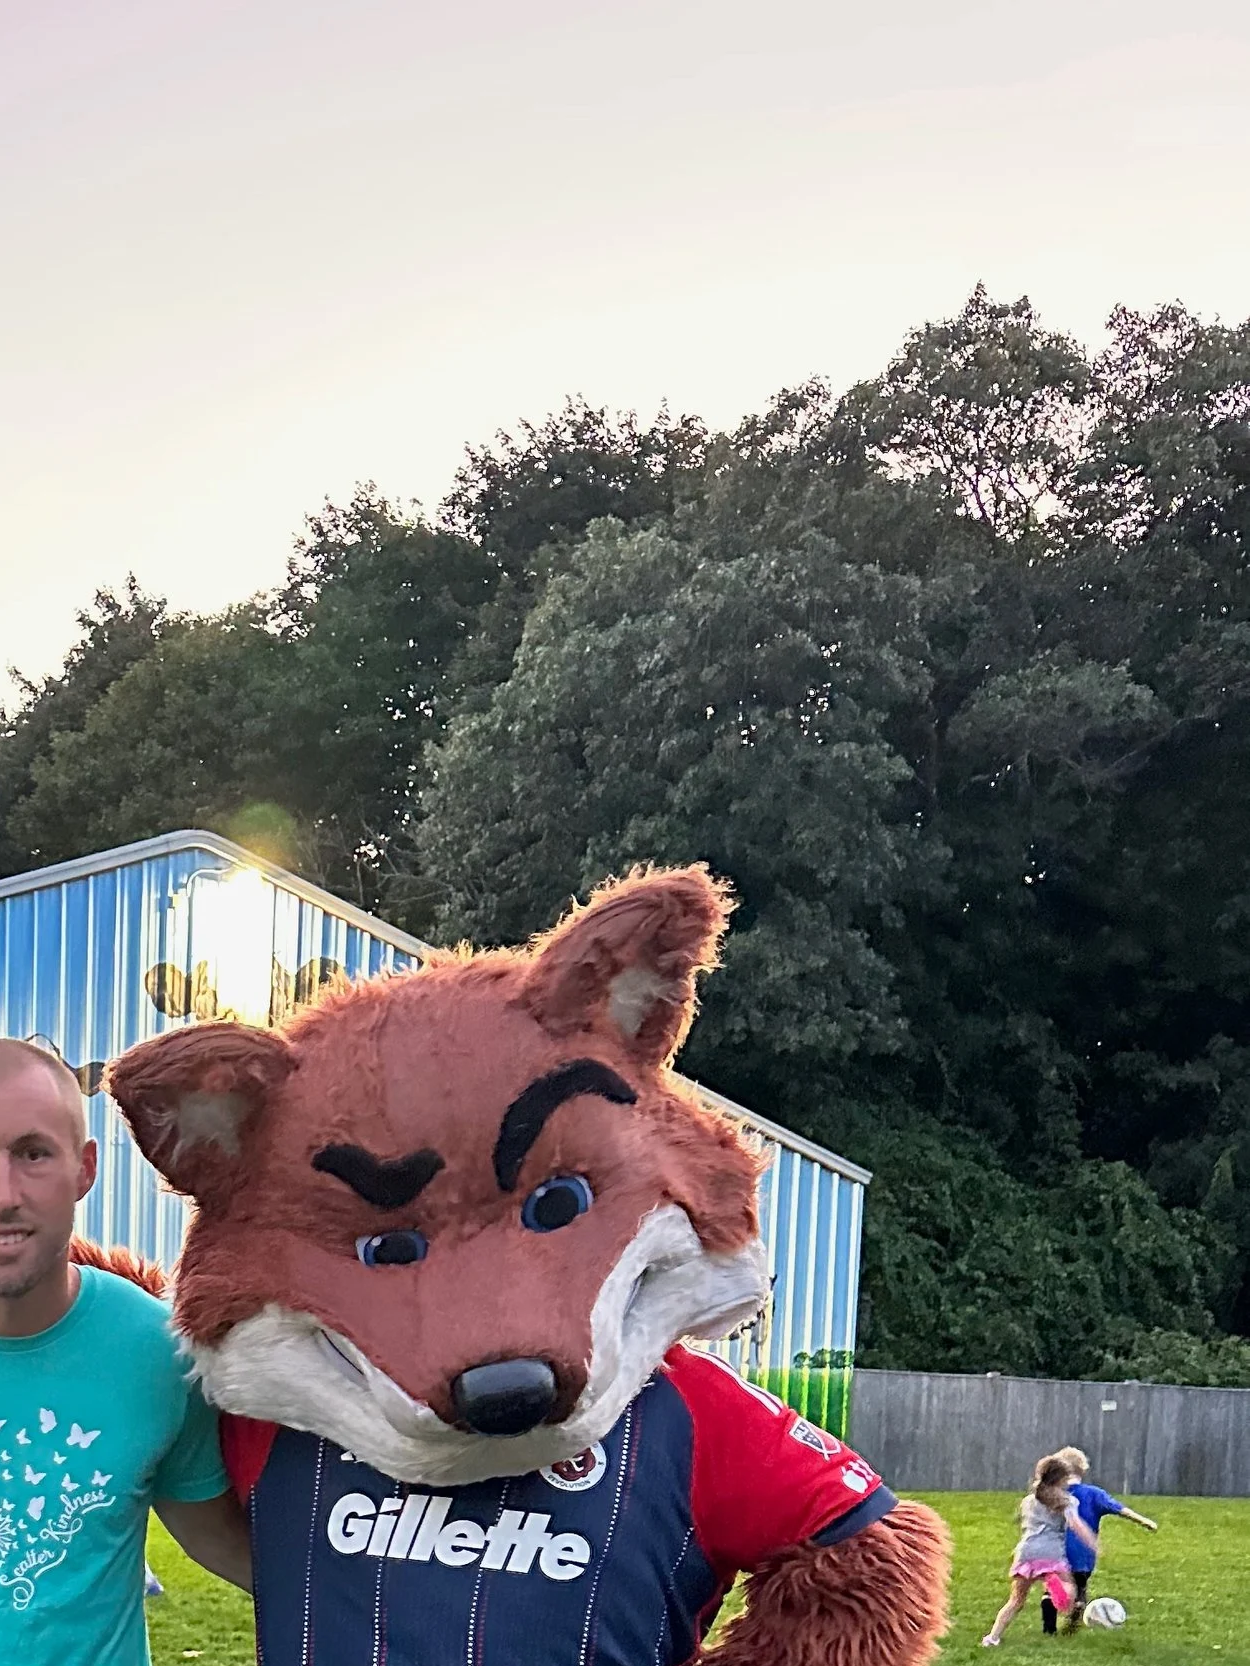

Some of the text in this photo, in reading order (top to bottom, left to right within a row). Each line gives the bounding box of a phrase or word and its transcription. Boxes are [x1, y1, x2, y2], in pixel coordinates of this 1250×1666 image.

[0, 1488, 108, 1611] Scatter Kindness
[327, 1492, 591, 1581] Gillette
